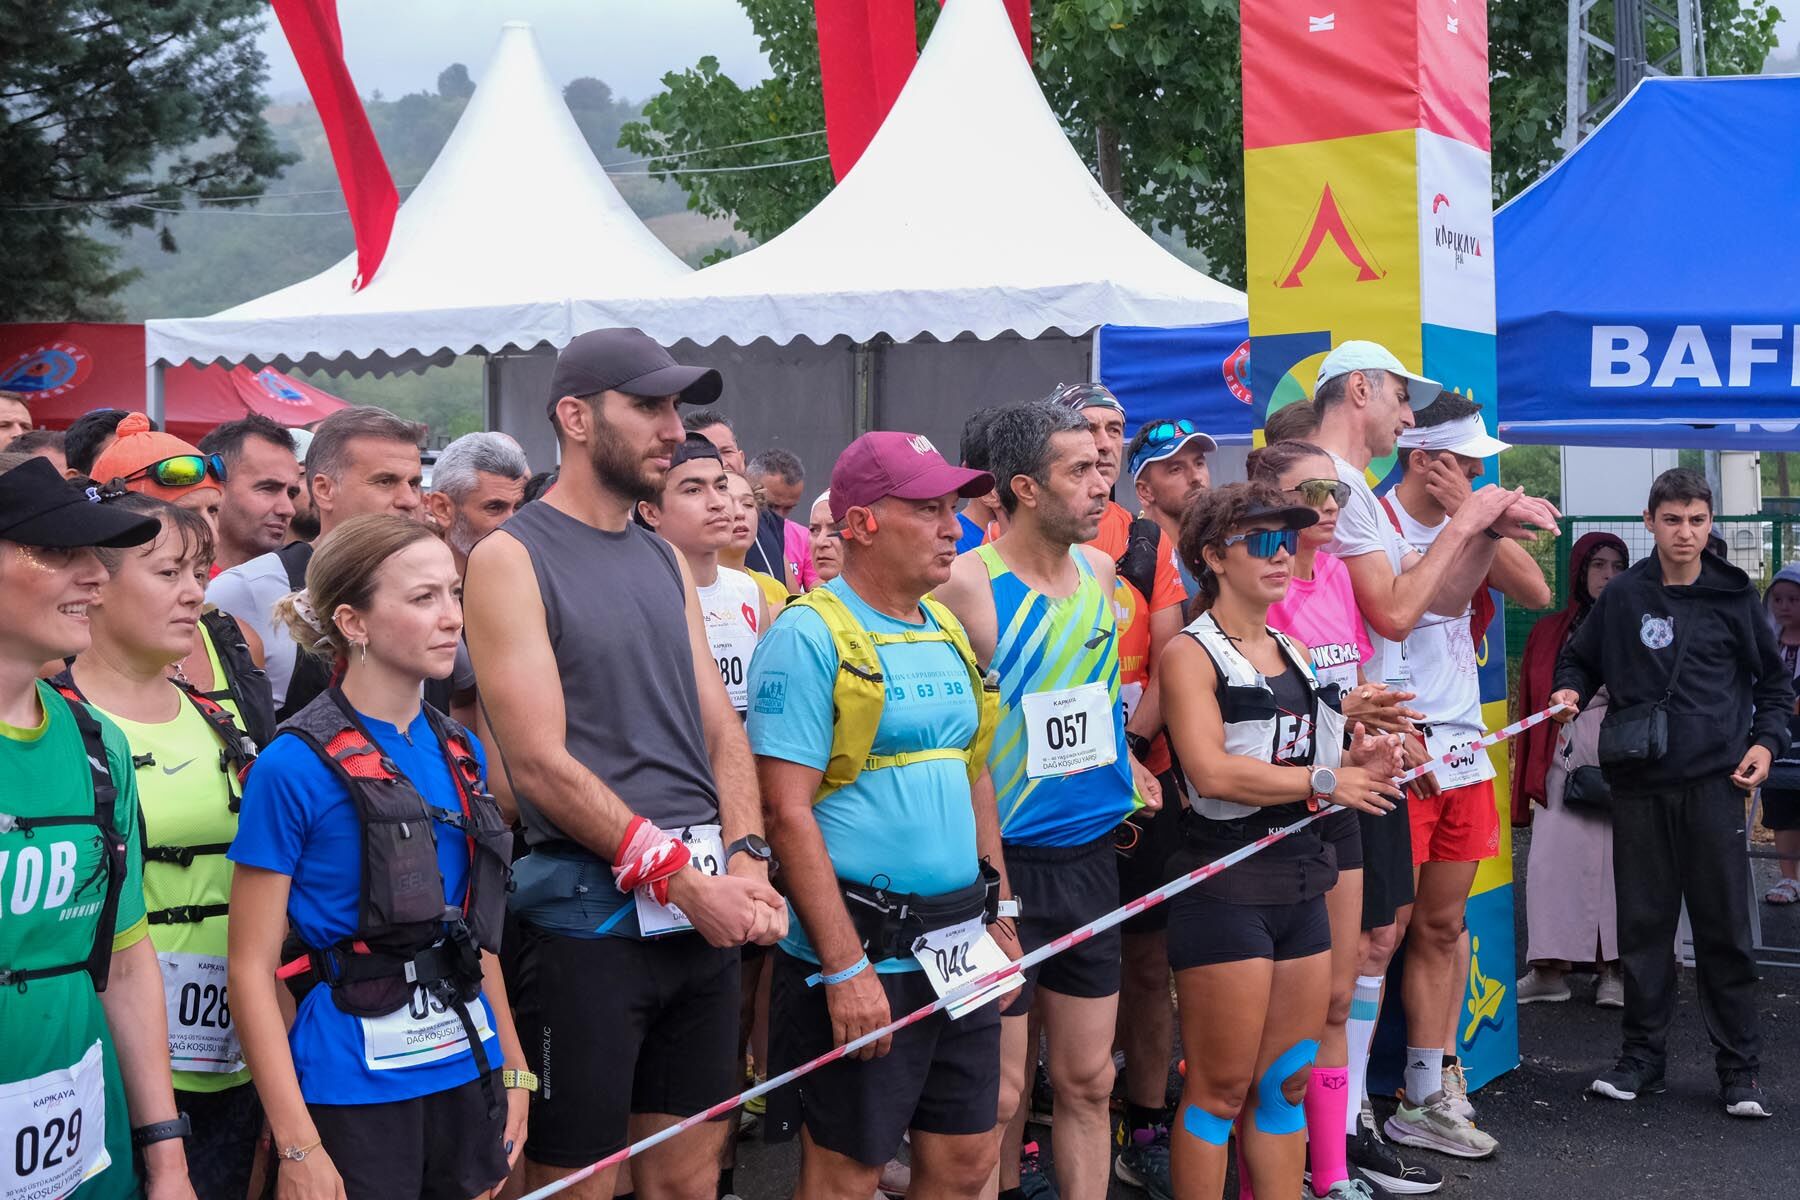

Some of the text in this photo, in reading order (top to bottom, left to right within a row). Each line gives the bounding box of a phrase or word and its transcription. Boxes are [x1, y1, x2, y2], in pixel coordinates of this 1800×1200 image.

[1590, 324, 1800, 388] BAF
[714, 655, 743, 687] 80
[917, 684, 934, 698] 63
[944, 682, 964, 696] 38
[1046, 711, 1087, 750] 057
[935, 941, 977, 983] 042
[178, 982, 231, 1029] 028
[33, 1088, 76, 1109] KAPIKAYA
[15, 1107, 82, 1177] 029
